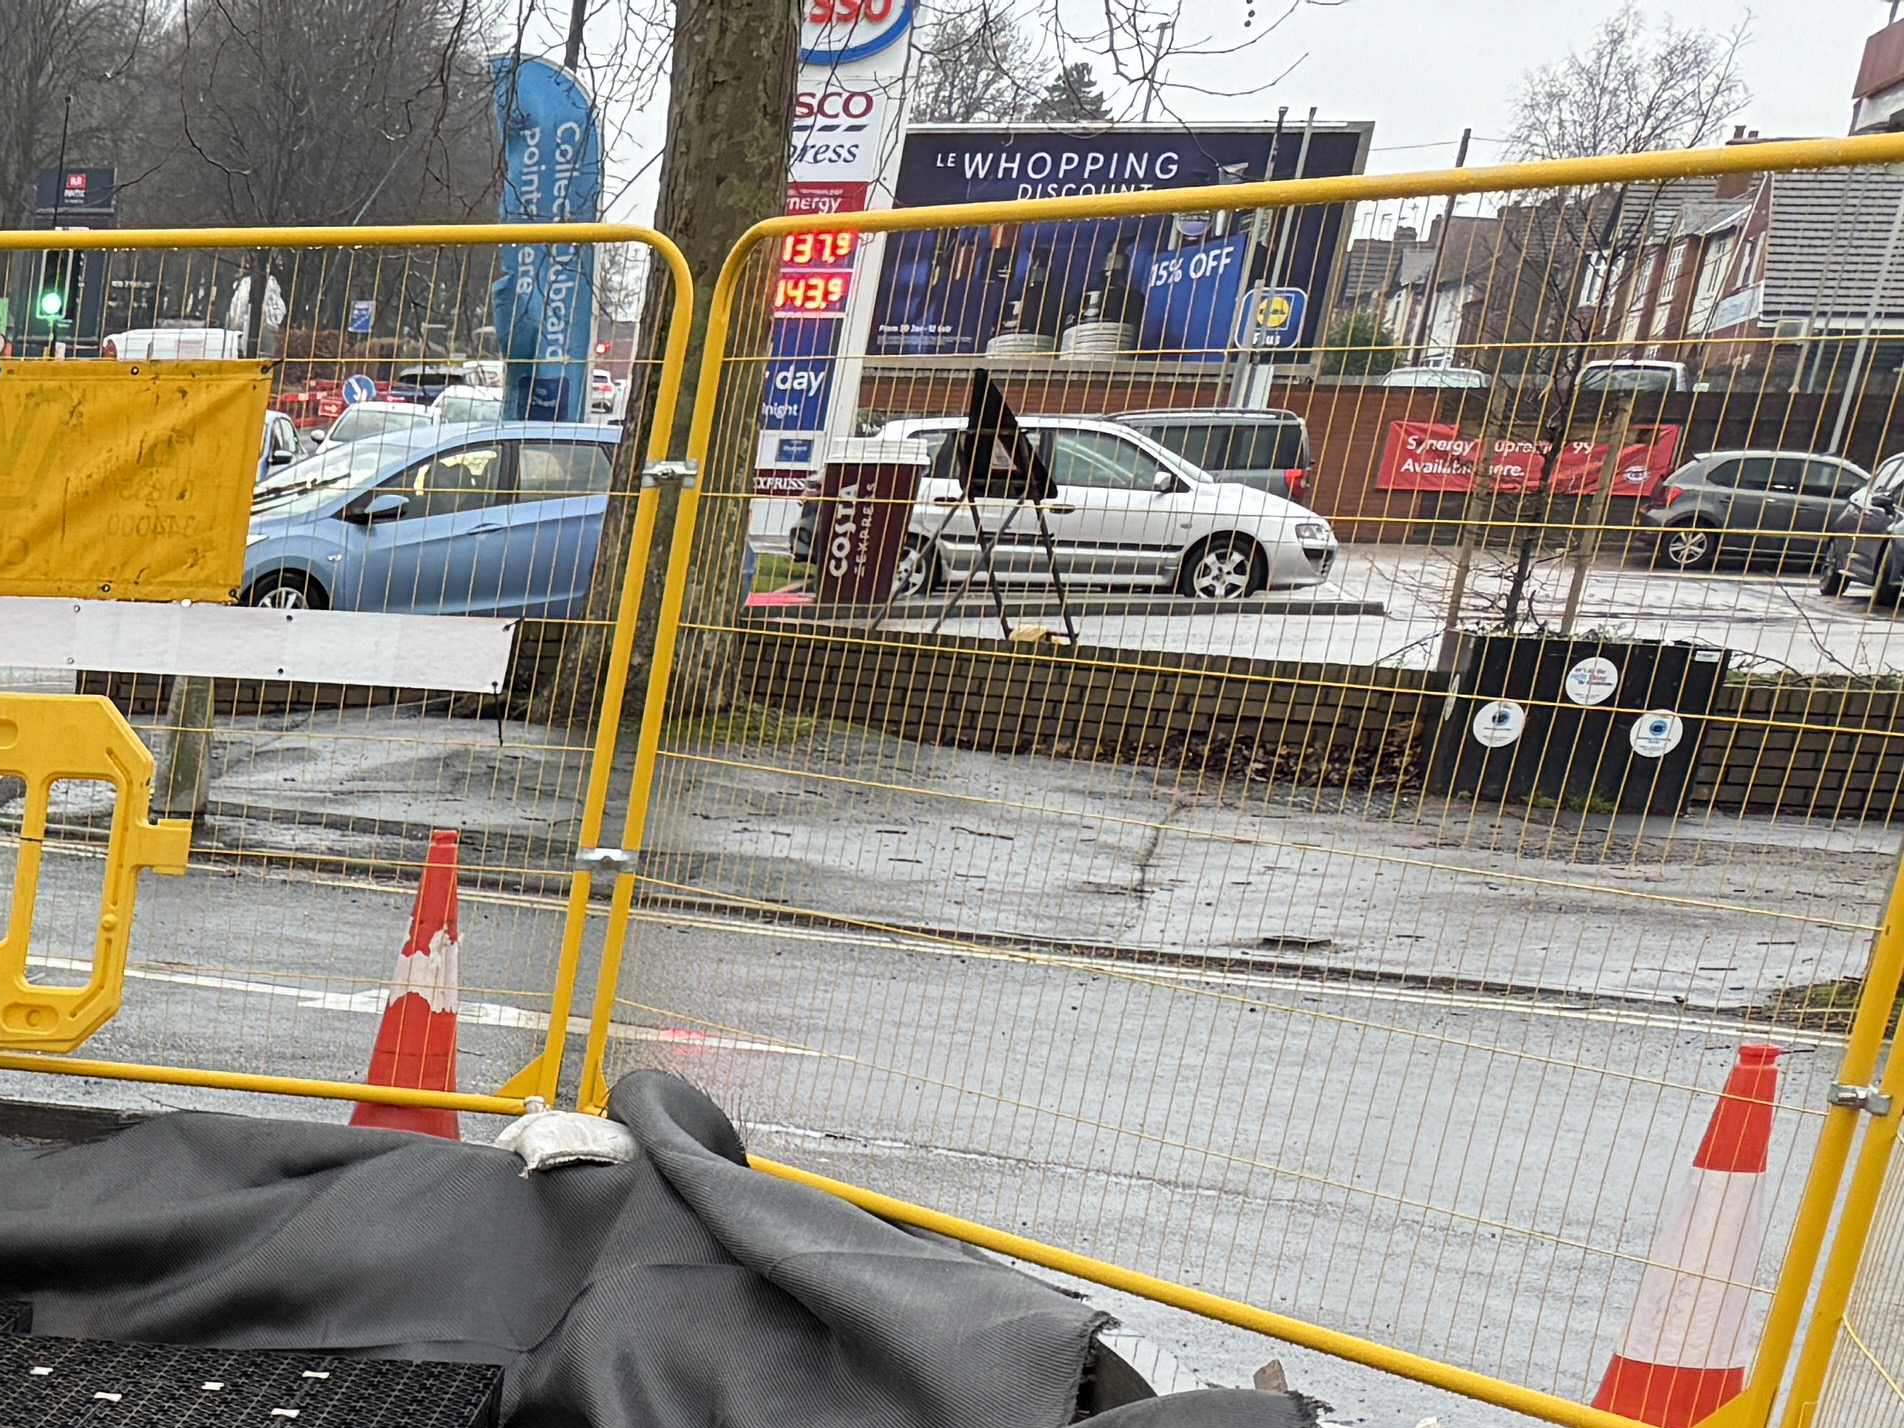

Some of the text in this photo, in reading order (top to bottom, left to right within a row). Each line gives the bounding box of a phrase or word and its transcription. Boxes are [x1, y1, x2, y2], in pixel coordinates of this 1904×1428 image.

[795, 91, 874, 119] SCO
[936, 151, 1180, 180] LE WHOPPING
[789, 196, 842, 214] nergy
[782, 233, 852, 264] 137.9
[1189, 246, 1234, 279] OFF
[517, 246, 535, 294] ere
[774, 277, 844, 309] 143.9
[775, 365, 825, 396] day
